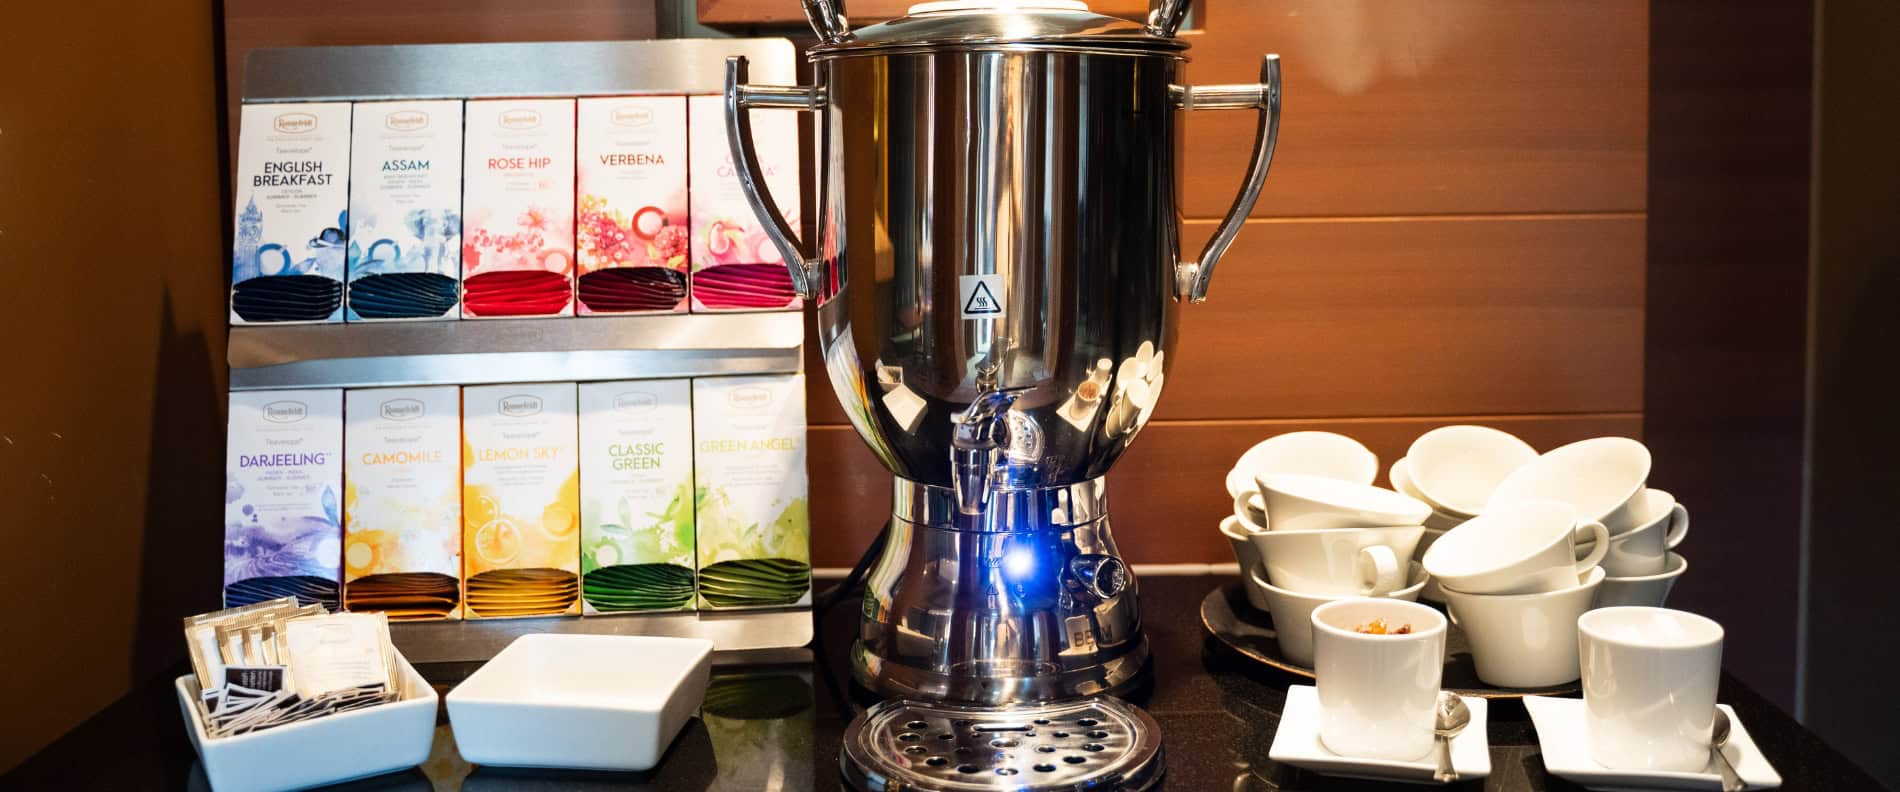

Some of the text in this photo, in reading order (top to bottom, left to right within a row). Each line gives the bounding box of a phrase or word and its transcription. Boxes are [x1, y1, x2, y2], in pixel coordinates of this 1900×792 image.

[382, 159, 430, 172] ASSAM
[488, 157, 551, 170] ROSE HIP
[600, 154, 664, 166] VERBENA
[264, 161, 323, 174] ENGLISH
[253, 173, 334, 187] BREAKFAST
[608, 442, 664, 457] CLASSIC
[700, 439, 747, 454] GREEN
[361, 449, 442, 465] CAMOMILE
[479, 447, 529, 462] LEMON
[612, 456, 661, 471] GREEN
